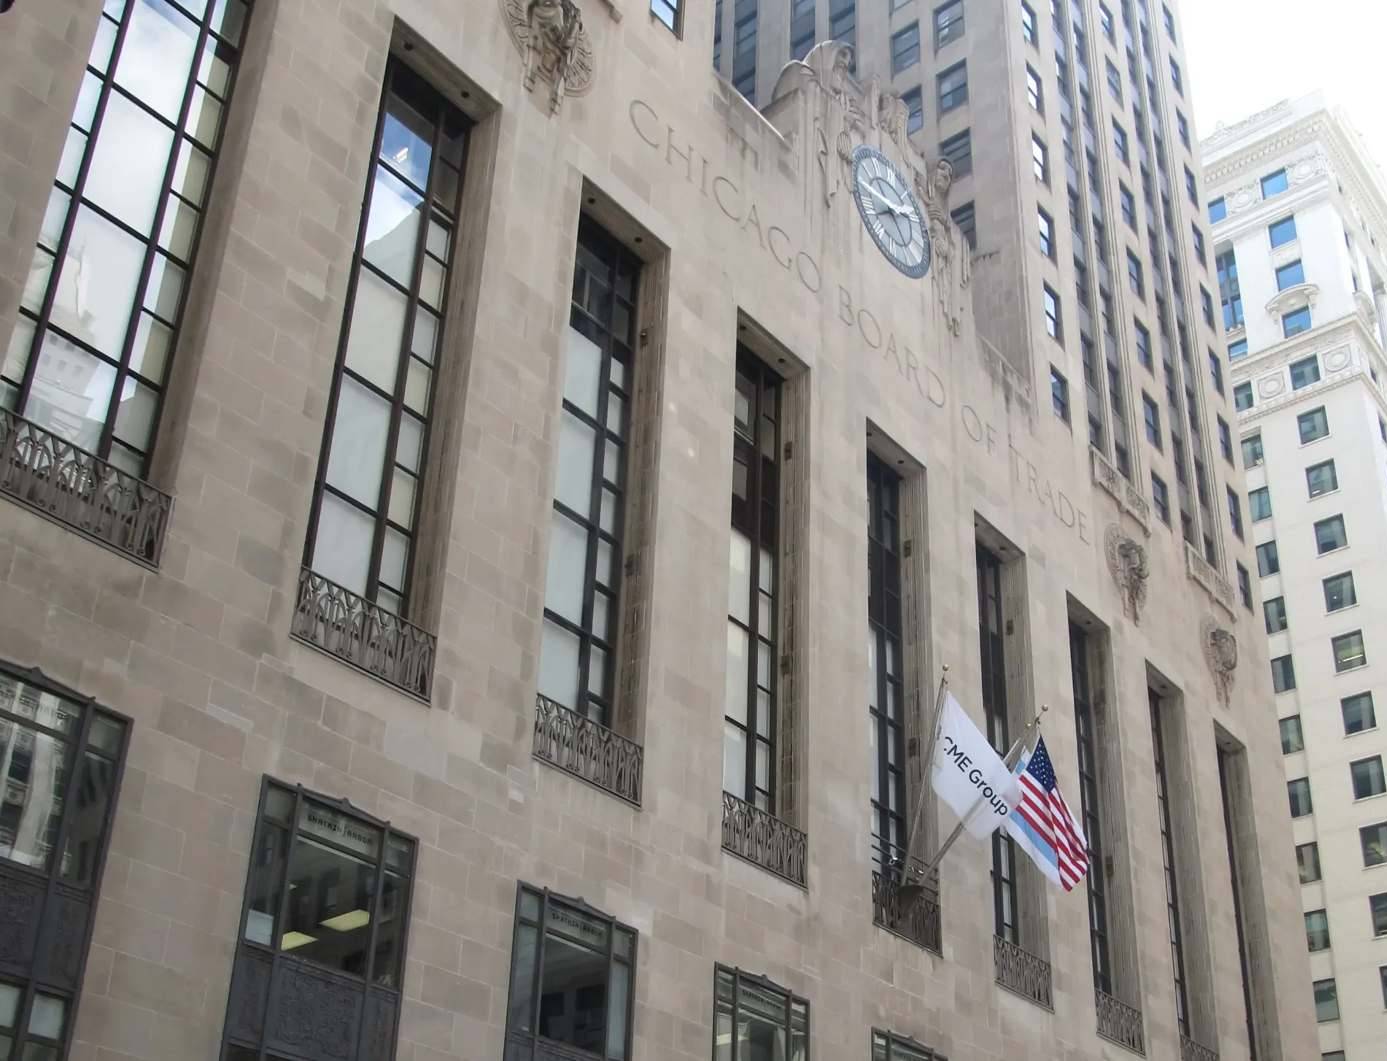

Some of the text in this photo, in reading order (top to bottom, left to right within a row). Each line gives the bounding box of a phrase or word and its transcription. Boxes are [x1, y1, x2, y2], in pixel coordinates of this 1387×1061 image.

[629, 99, 1091, 546] CHICAGO BOARD OF TRADE
[968, 769, 1008, 816] Group
